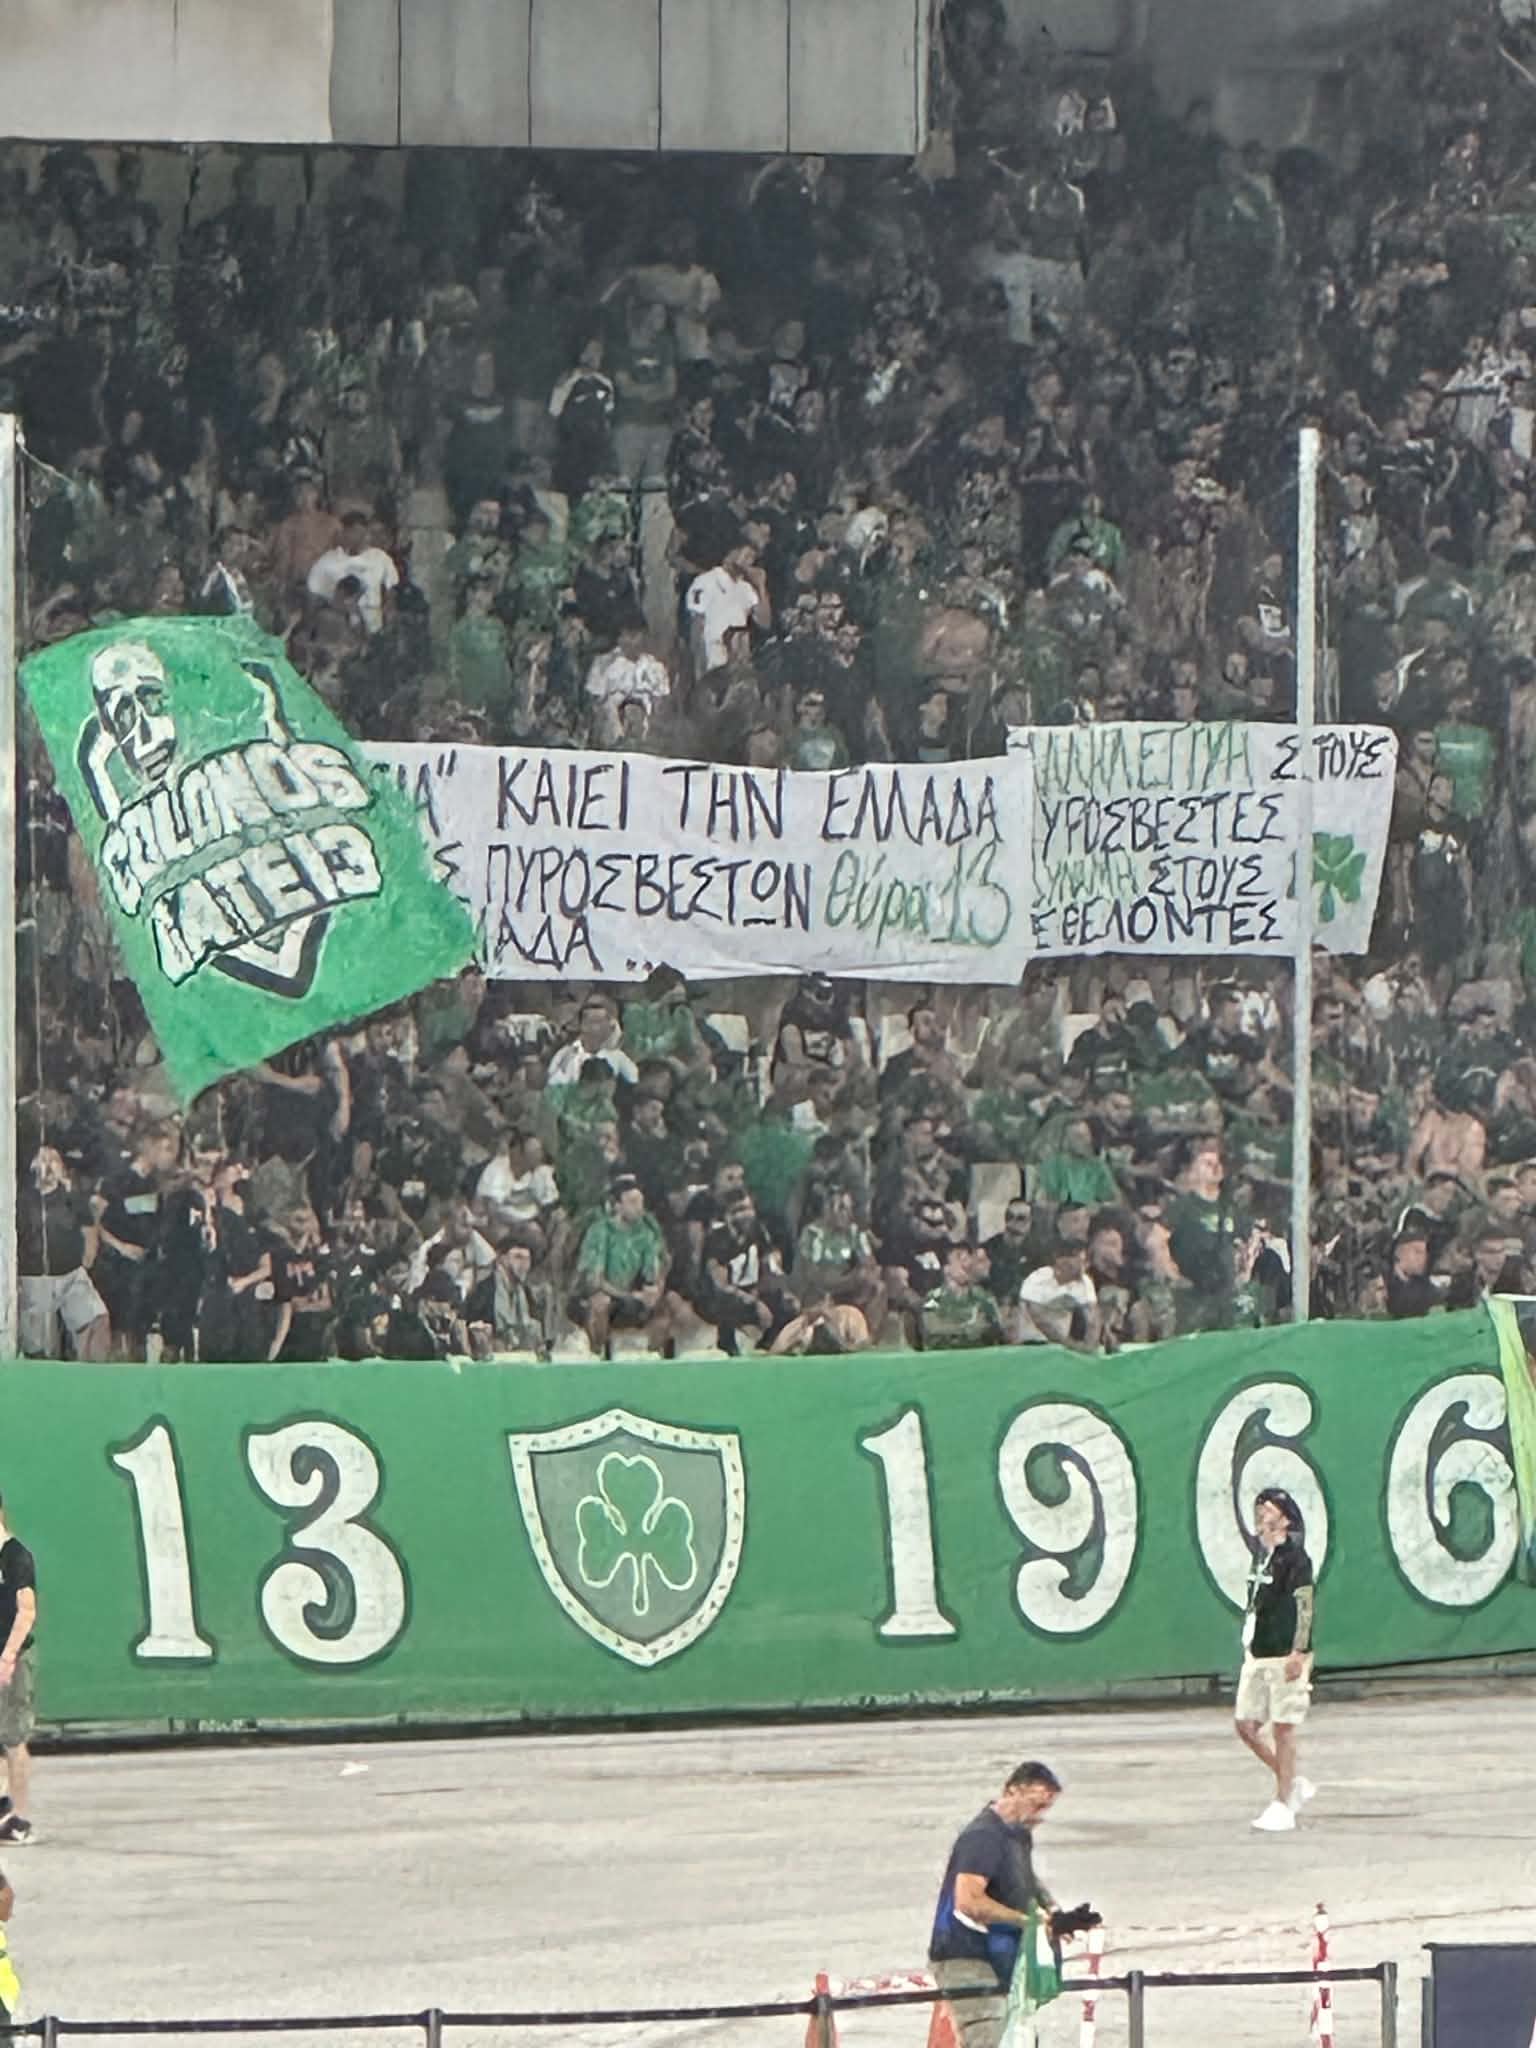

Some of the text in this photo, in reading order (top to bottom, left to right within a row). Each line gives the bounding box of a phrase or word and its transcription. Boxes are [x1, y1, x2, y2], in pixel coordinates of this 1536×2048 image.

[1270, 731, 1390, 780] ΣΤΟΥΣ
[497, 755, 629, 831] ΚΑΙΕΙ
[662, 764, 785, 842] ΤΗΝ
[821, 768, 1003, 846] ΕΛΛΑΔΑ
[1032, 790, 1285, 862] ΥΡΟΣΒΕΣΤΕΣ
[486, 844, 812, 933] ΠΥΡΟΣΒΕΣΤΩΝ
[109, 1372, 1519, 1666] 13 1966
